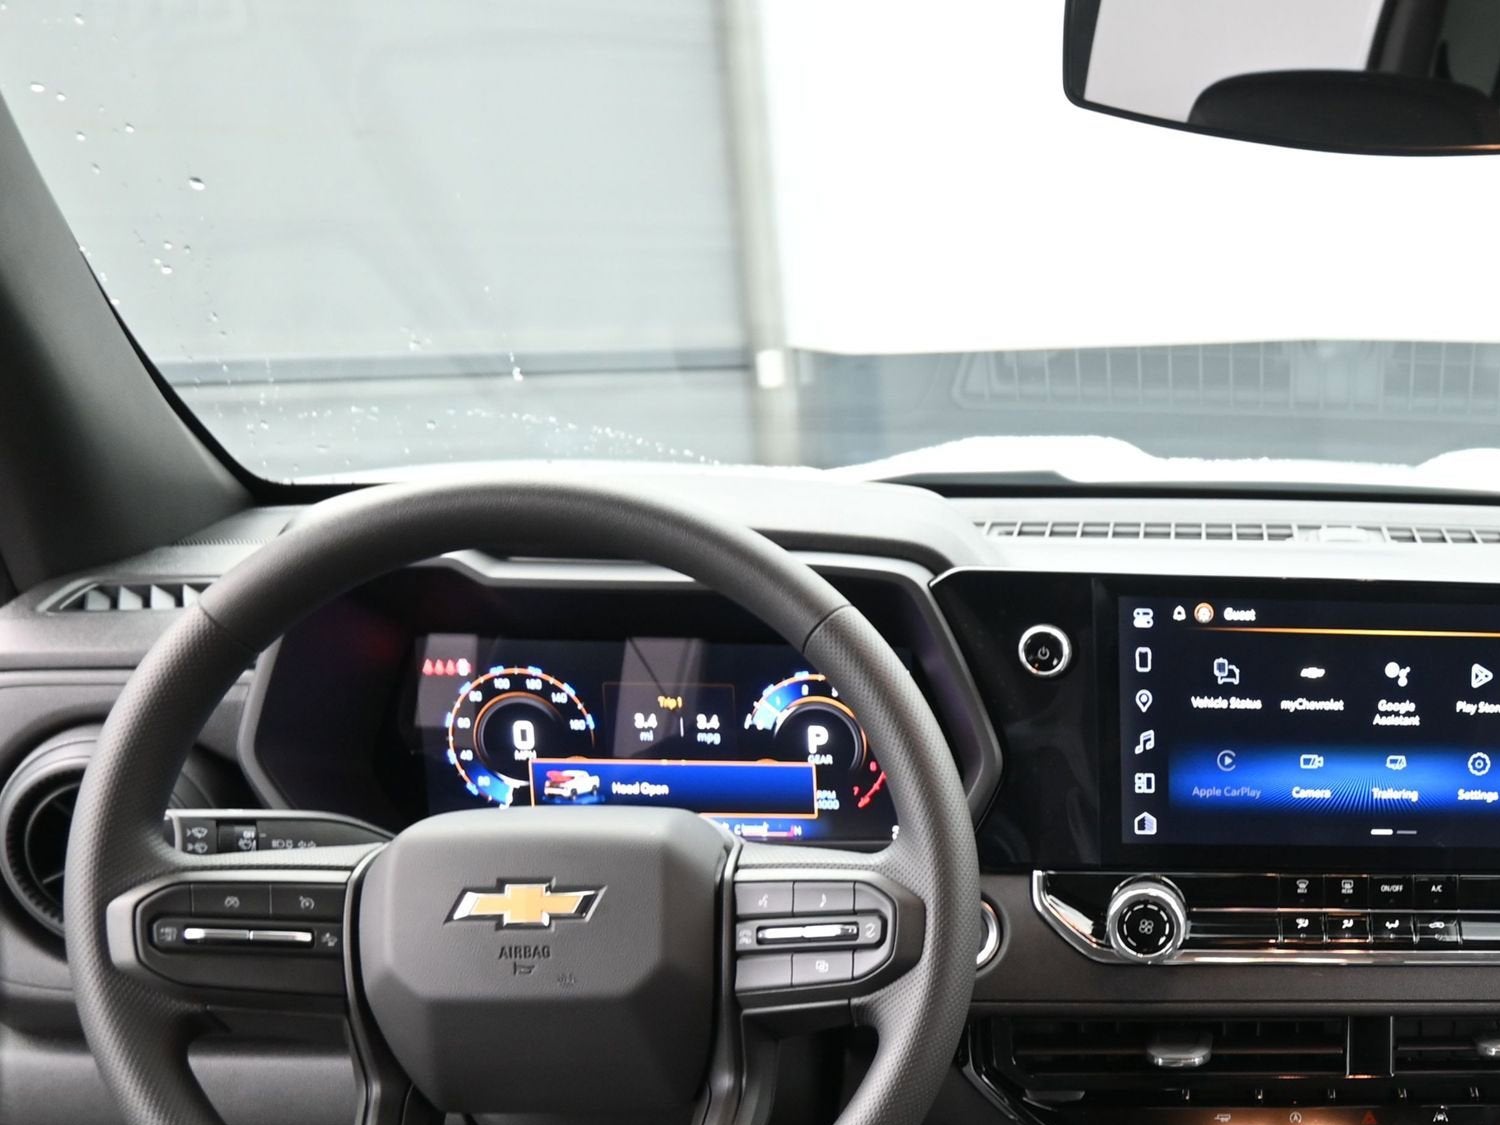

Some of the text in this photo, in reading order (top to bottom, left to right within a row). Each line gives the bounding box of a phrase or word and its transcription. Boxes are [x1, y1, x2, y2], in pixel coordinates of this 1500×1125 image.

[1223, 607, 1256, 621] Guest
[1191, 696, 1263, 710] Vehicle Status
[1280, 698, 1345, 712] myChevrolet
[1378, 699, 1416, 714] Google
[1456, 701, 1478, 715] Play
[1373, 714, 1421, 726] Assistant
[513, 720, 535, 751] 0
[697, 733, 721, 745] mpg
[807, 725, 829, 754] P
[807, 754, 833, 765] GEAR
[611, 781, 670, 797] Hood Open
[1192, 786, 1262, 799] Apple CarPlay
[1291, 786, 1332, 800] Camera
[1372, 787, 1419, 802] Trailering
[1457, 788, 1499, 803] Settings
[1380, 884, 1404, 893] ON/OFF
[1430, 884, 1443, 893] A/C
[498, 945, 551, 961] AIRBAG
